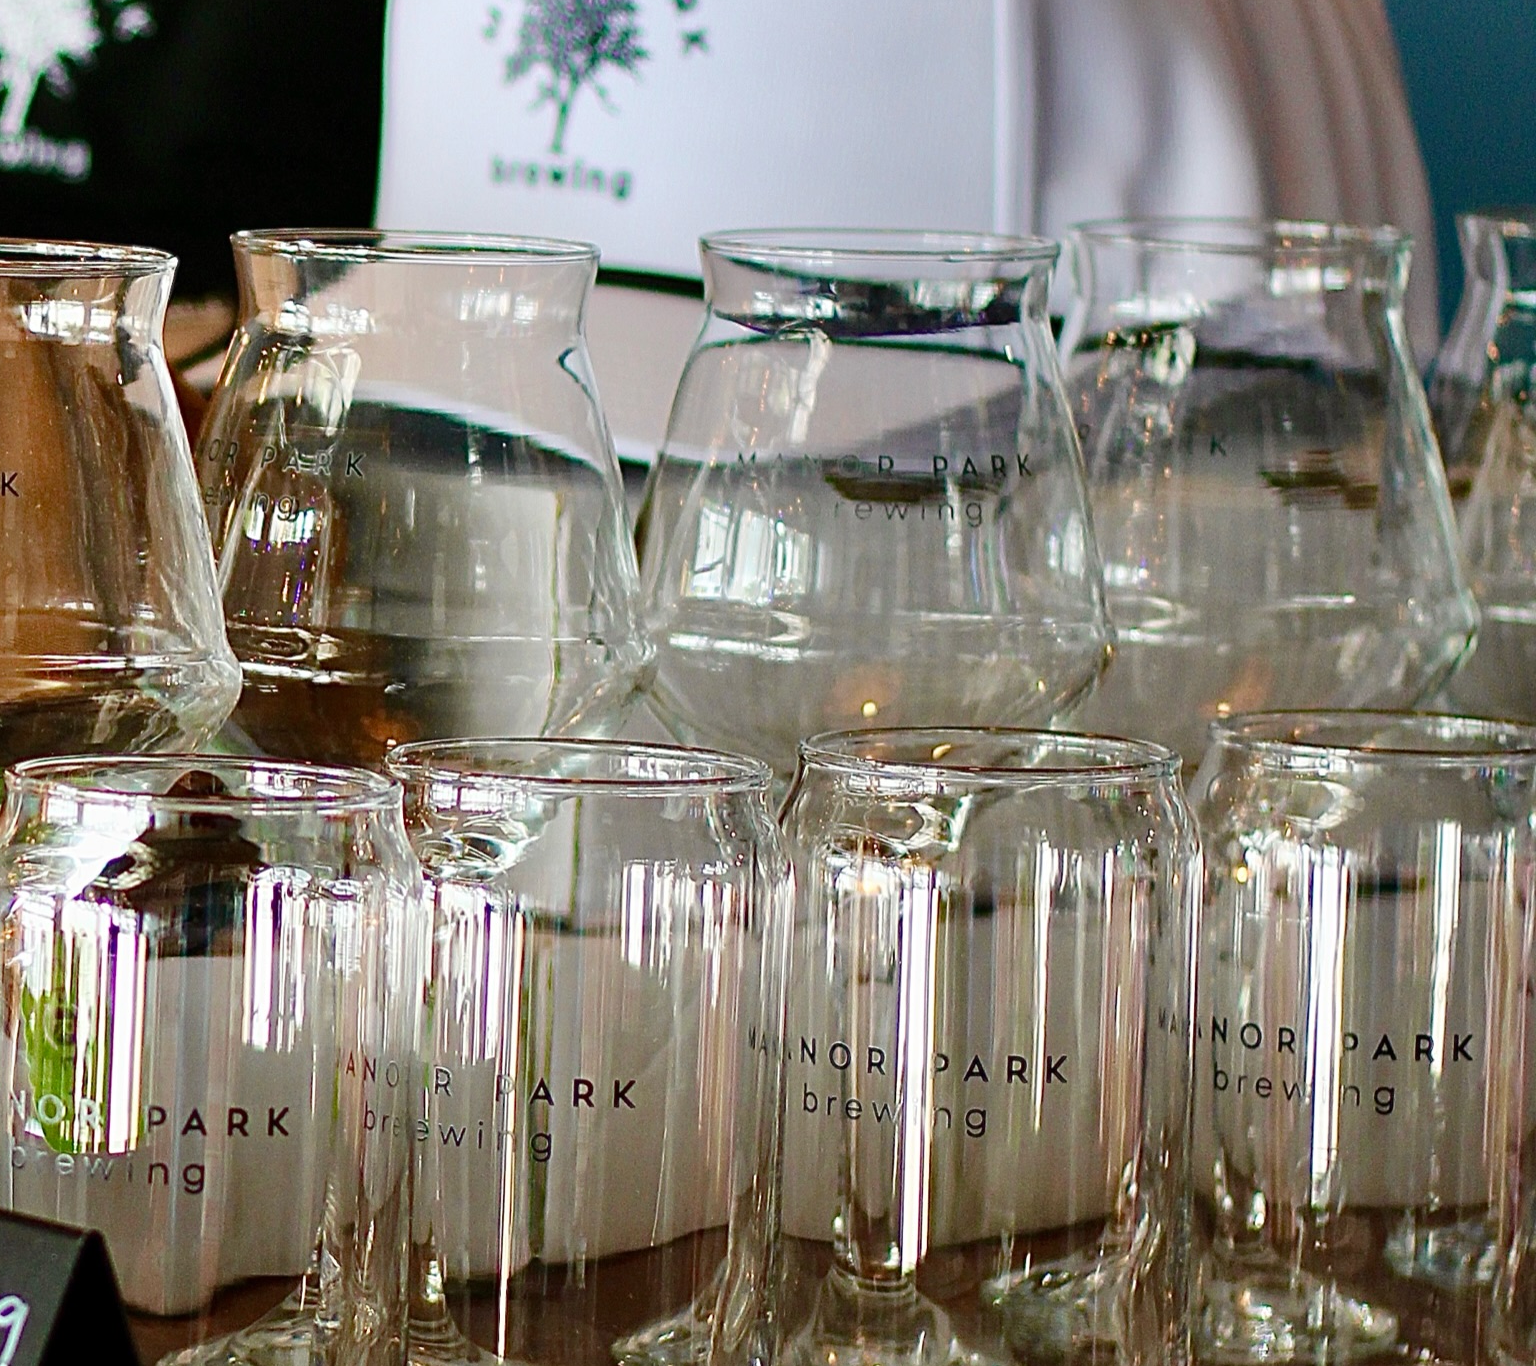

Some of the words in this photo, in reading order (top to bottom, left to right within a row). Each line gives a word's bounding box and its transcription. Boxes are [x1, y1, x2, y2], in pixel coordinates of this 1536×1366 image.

[488, 155, 634, 203] brewing
[932, 454, 1032, 478] PARK
[346, 1051, 451, 1097] ANOR
[496, 1075, 636, 1109] PARK
[148, 1106, 290, 1136] PARK
